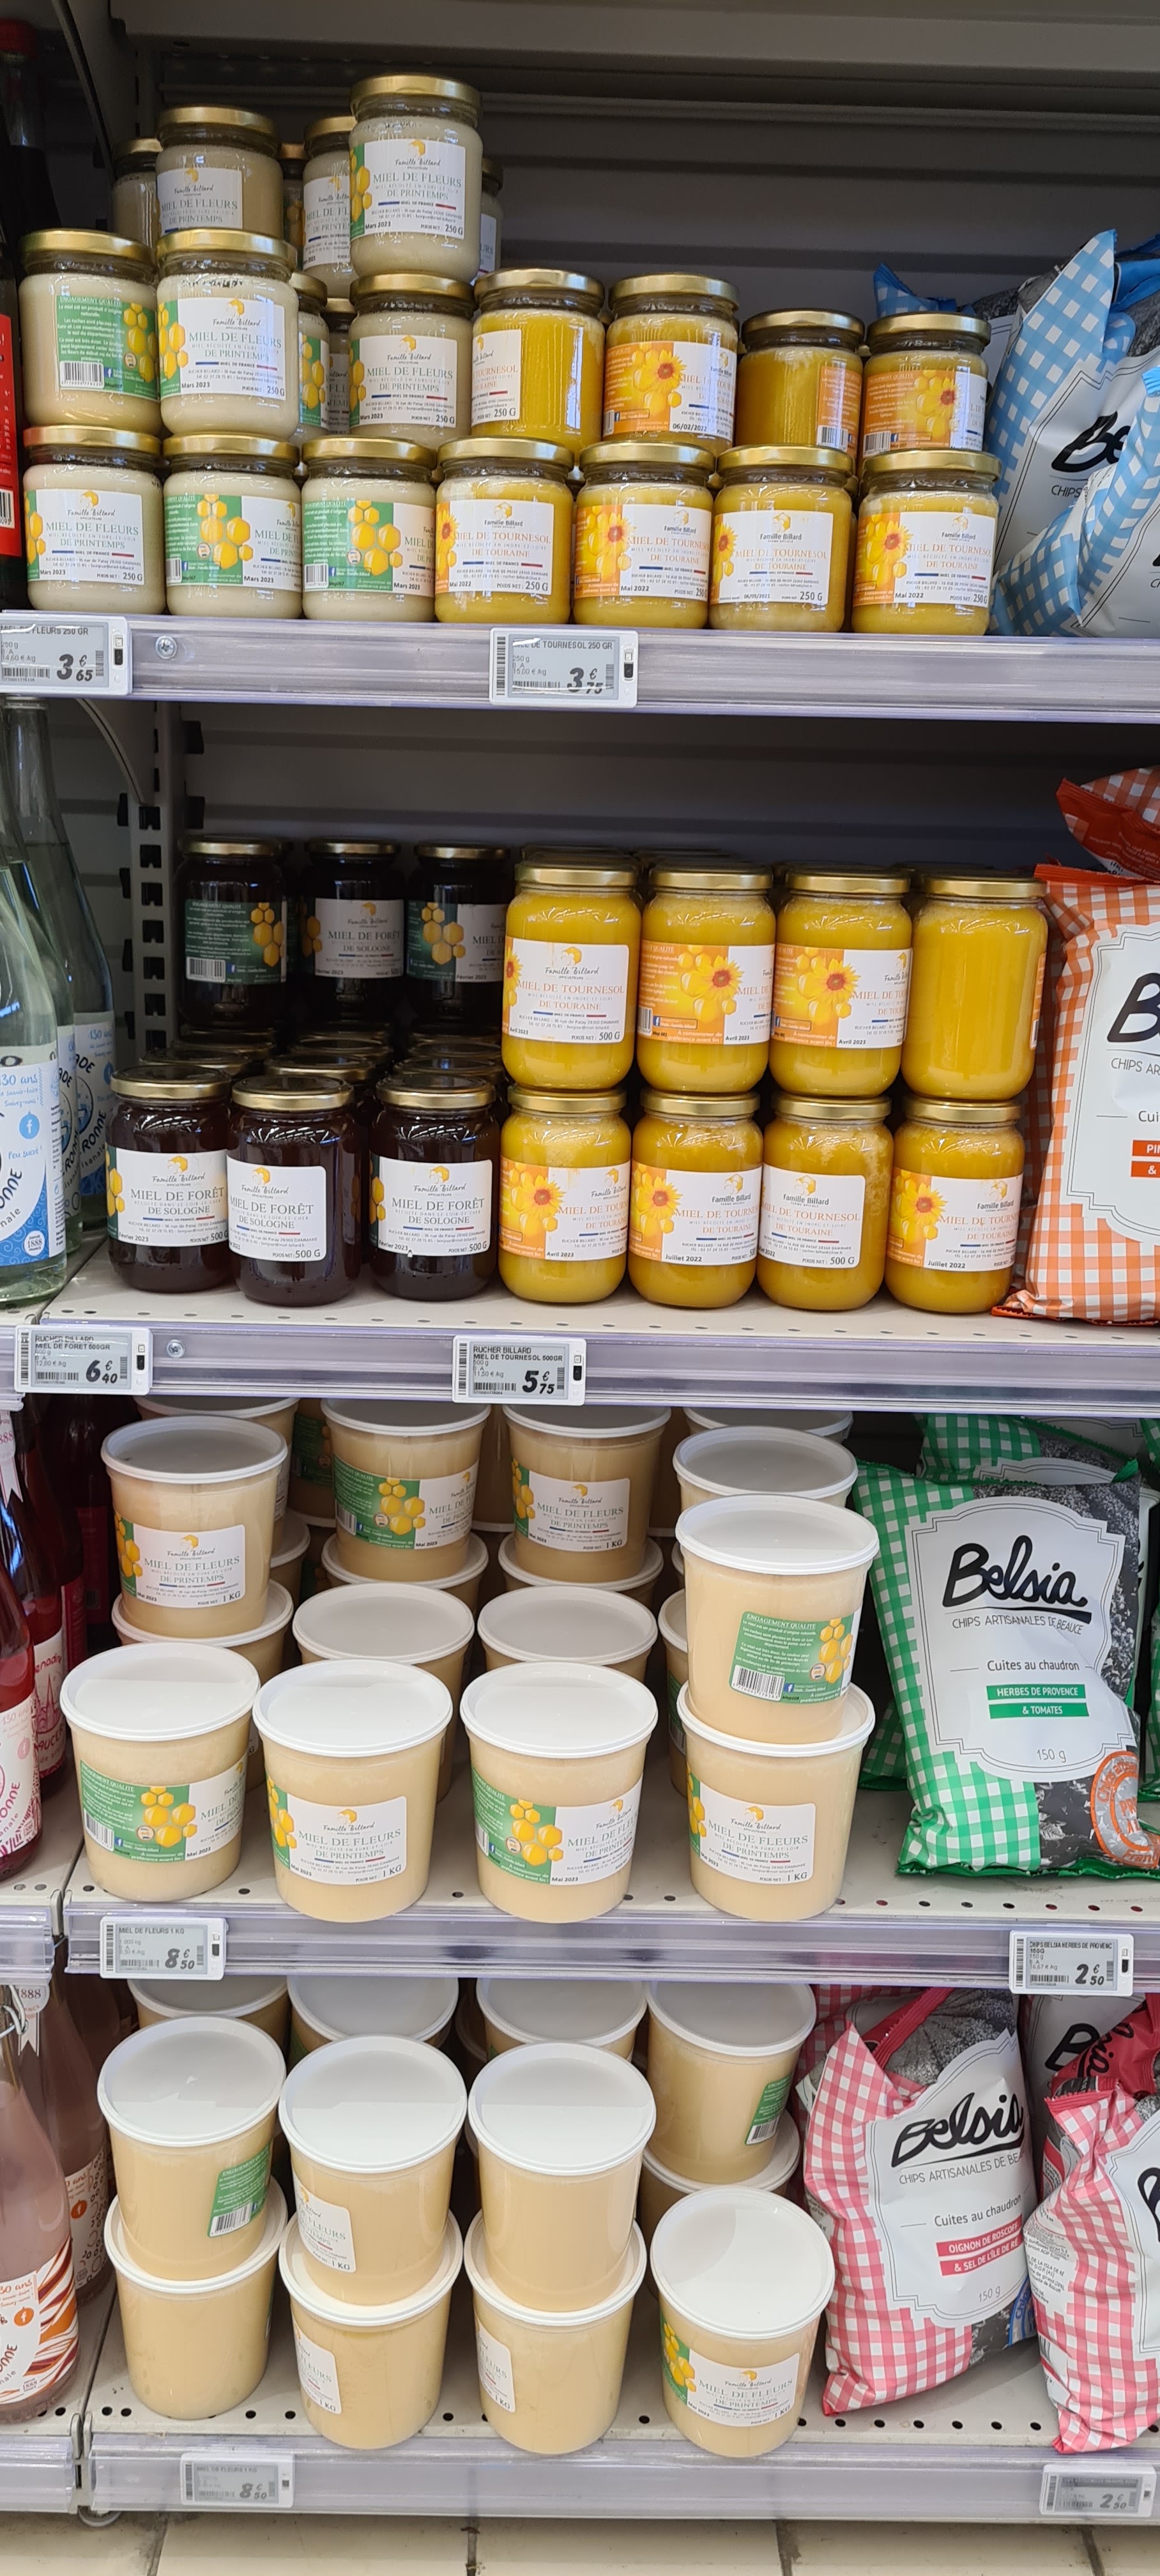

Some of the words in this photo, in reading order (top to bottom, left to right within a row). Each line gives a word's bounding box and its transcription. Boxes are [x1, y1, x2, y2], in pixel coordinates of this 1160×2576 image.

[374, 172, 399, 183] MIEL
[403, 172, 418, 181] DE
[422, 173, 461, 187] FLEURS
[401, 190, 448, 200] PRINTEMPS
[445, 224, 456, 233] 250
[458, 227, 463, 235] G
[1051, 484, 1082, 498] CHIPS
[46, 521, 72, 532] MIEL
[75, 522, 93, 532] DE
[96, 524, 139, 536] FLEURS
[505, 519, 523, 527] Billard
[60, 538, 72, 547] DE
[74, 539, 126, 549] PRINTEMPS
[454, 532, 473, 540] MIEL
[476, 532, 489, 540] DE
[492, 532, 551, 544] TOURNESOL
[471, 548, 484, 556] DE
[486, 548, 530, 558] TOURAINE
[525, 580, 541, 591] 250
[542, 582, 549, 591] G
[32, 626, 61, 634] FLEURS
[543, 641, 587, 649] TOURNESOL
[588, 641, 600, 650] 250
[56, 654, 74, 680] 3
[79, 655, 88, 667] €
[76, 670, 93, 682] 65
[567, 667, 584, 693] 3
[590, 668, 597, 680] €
[586, 682, 603, 694] 75
[545, 965, 570, 975] Famille
[572, 965, 600, 976] Billard
[517, 980, 540, 992] MIEL
[543, 982, 560, 992] DE
[562, 983, 624, 995] TOURNESOL
[538, 1000, 551, 1009] DE
[553, 1000, 602, 1010] TOURAINE
[599, 1031, 613, 1041] 500
[614, 1031, 621, 1041] G
[1111, 1057, 1142, 1072] CHIPS
[20, 1073, 38, 1084] ans
[439, 1183, 467, 1192] Billard
[392, 1197, 422, 1211] MIEL
[426, 1201, 445, 1211] DE
[448, 1197, 485, 1211] FORÊT
[408, 1215, 422, 1224] DE
[424, 1215, 470, 1225] SOLOGNE
[394, 1243, 409, 1252] 2023
[469, 1243, 481, 1252] 500
[482, 1241, 488, 1250] G
[665, 1254, 684, 1263] Juillet
[86, 1360, 101, 1383] 6
[105, 1360, 112, 1371] €
[102, 1373, 118, 1384] 40
[522, 1370, 540, 1393] 5
[542, 1371, 550, 1382] €
[539, 1383, 555, 1395] 75
[942, 1535, 1088, 1607] Belsia
[746, 1613, 790, 1629] ENGAGEMENT
[952, 1616, 981, 1629] CHIPS
[985, 1614, 1046, 1626] ARTISANALES
[1048, 1616, 1057, 1627] DE
[1057, 1619, 1084, 1635] BEAUCE
[987, 1660, 1021, 1671] Cuites
[1024, 1662, 1036, 1671] au
[1039, 1659, 1080, 1671] chaudron
[996, 1687, 1030, 1697] HERBES
[1031, 1687, 1041, 1696] DE
[1042, 1687, 1079, 1696] PROVENCE
[1022, 1706, 1029, 1715] &
[1032, 1706, 1063, 1715] TOMATES
[1037, 1748, 1055, 1761] 150
[1059, 1750, 1067, 1763] g
[708, 1819, 735, 1839] MIEL
[738, 1832, 755, 1844] DE
[759, 1835, 809, 1846] FLEURS
[722, 1841, 734, 1852] DE
[736, 1846, 790, 1859] PRINTEMPS
[794, 1871, 808, 1881] KG
[165, 1948, 181, 1968] 8
[183, 1949, 190, 1958] €
[179, 1959, 195, 1970] 50
[1093, 1964, 1100, 1974] €
[1074, 1963, 1089, 1984] 2
[1089, 1975, 1104, 1986] 50
[899, 2172, 926, 2185] CHIPS
[929, 2160, 993, 2182] ARTISANALES
[995, 2156, 1006, 2169] DE
[935, 2214, 968, 2227] Cuites
[971, 2211, 984, 2221] au
[986, 2193, 1022, 2218] chaudron
[949, 2241, 981, 2254] OIGNON
[982, 2236, 991, 2247] DE
[992, 2221, 1019, 2244] ROSCOFF
[954, 2263, 961, 2273] &
[963, 2258, 977, 2271] SEL
[978, 2255, 987, 2267] DE
[1002, 2245, 1010, 2257] DE
[1011, 2238, 1019, 2253] RÉ
[979, 2288, 993, 2303] 150
[995, 2285, 1001, 2299] g
[240, 2483, 254, 2499] 8
[1099, 2494, 1113, 2508] 2
